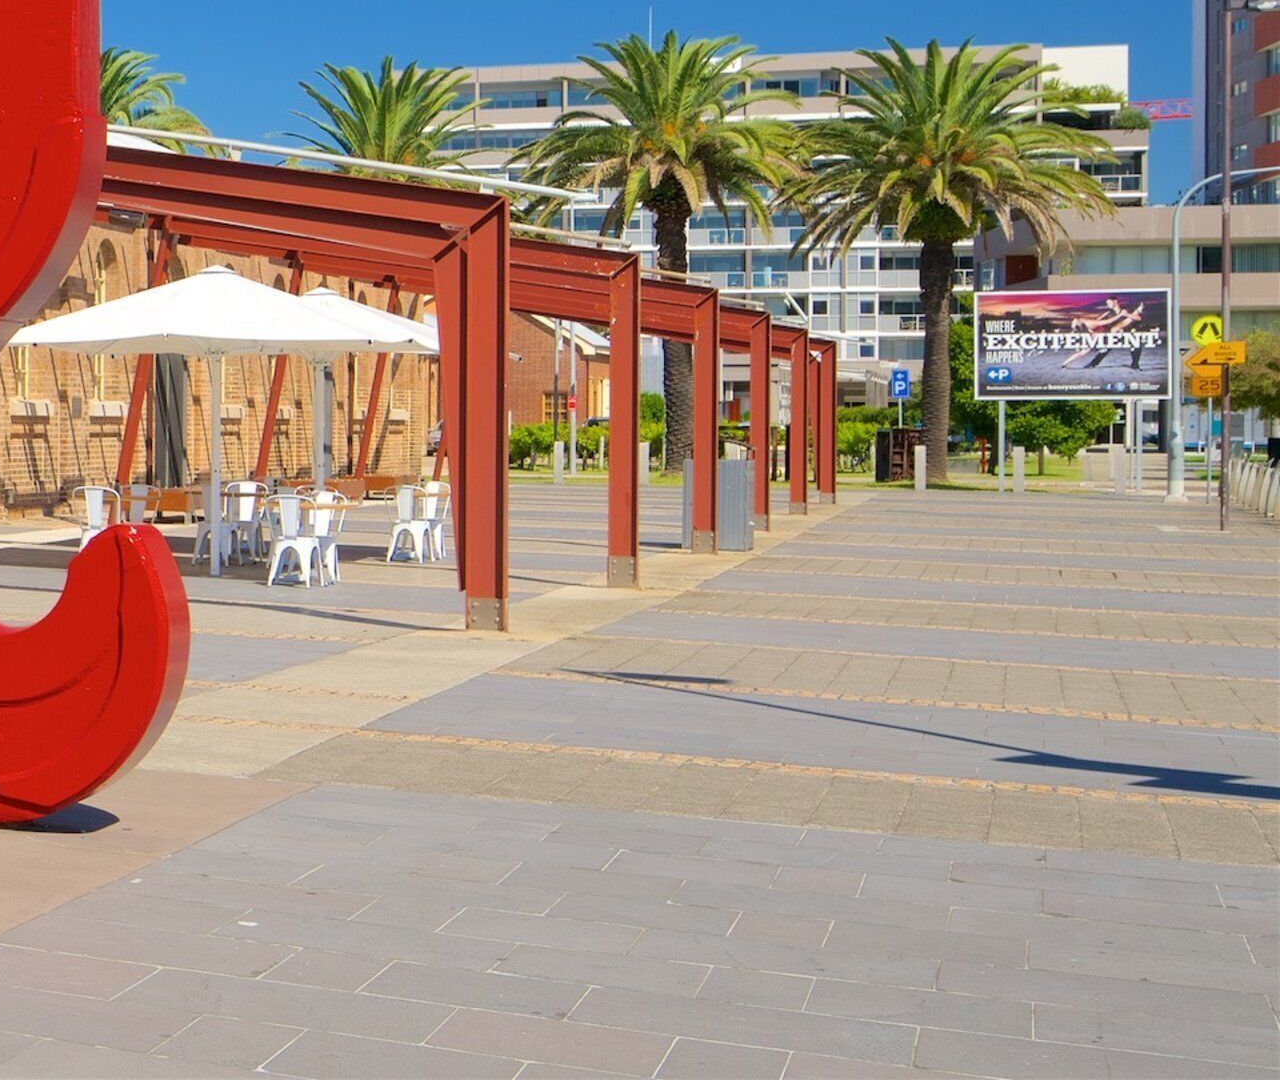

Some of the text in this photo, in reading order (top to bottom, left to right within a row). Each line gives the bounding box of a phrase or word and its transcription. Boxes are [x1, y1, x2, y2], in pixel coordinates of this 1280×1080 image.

[985, 320, 1016, 333] WHERE
[986, 351, 1024, 364] HAPPENS
[998, 368, 1009, 380] P
[895, 381, 906, 395] P
[1199, 380, 1220, 391] 25
